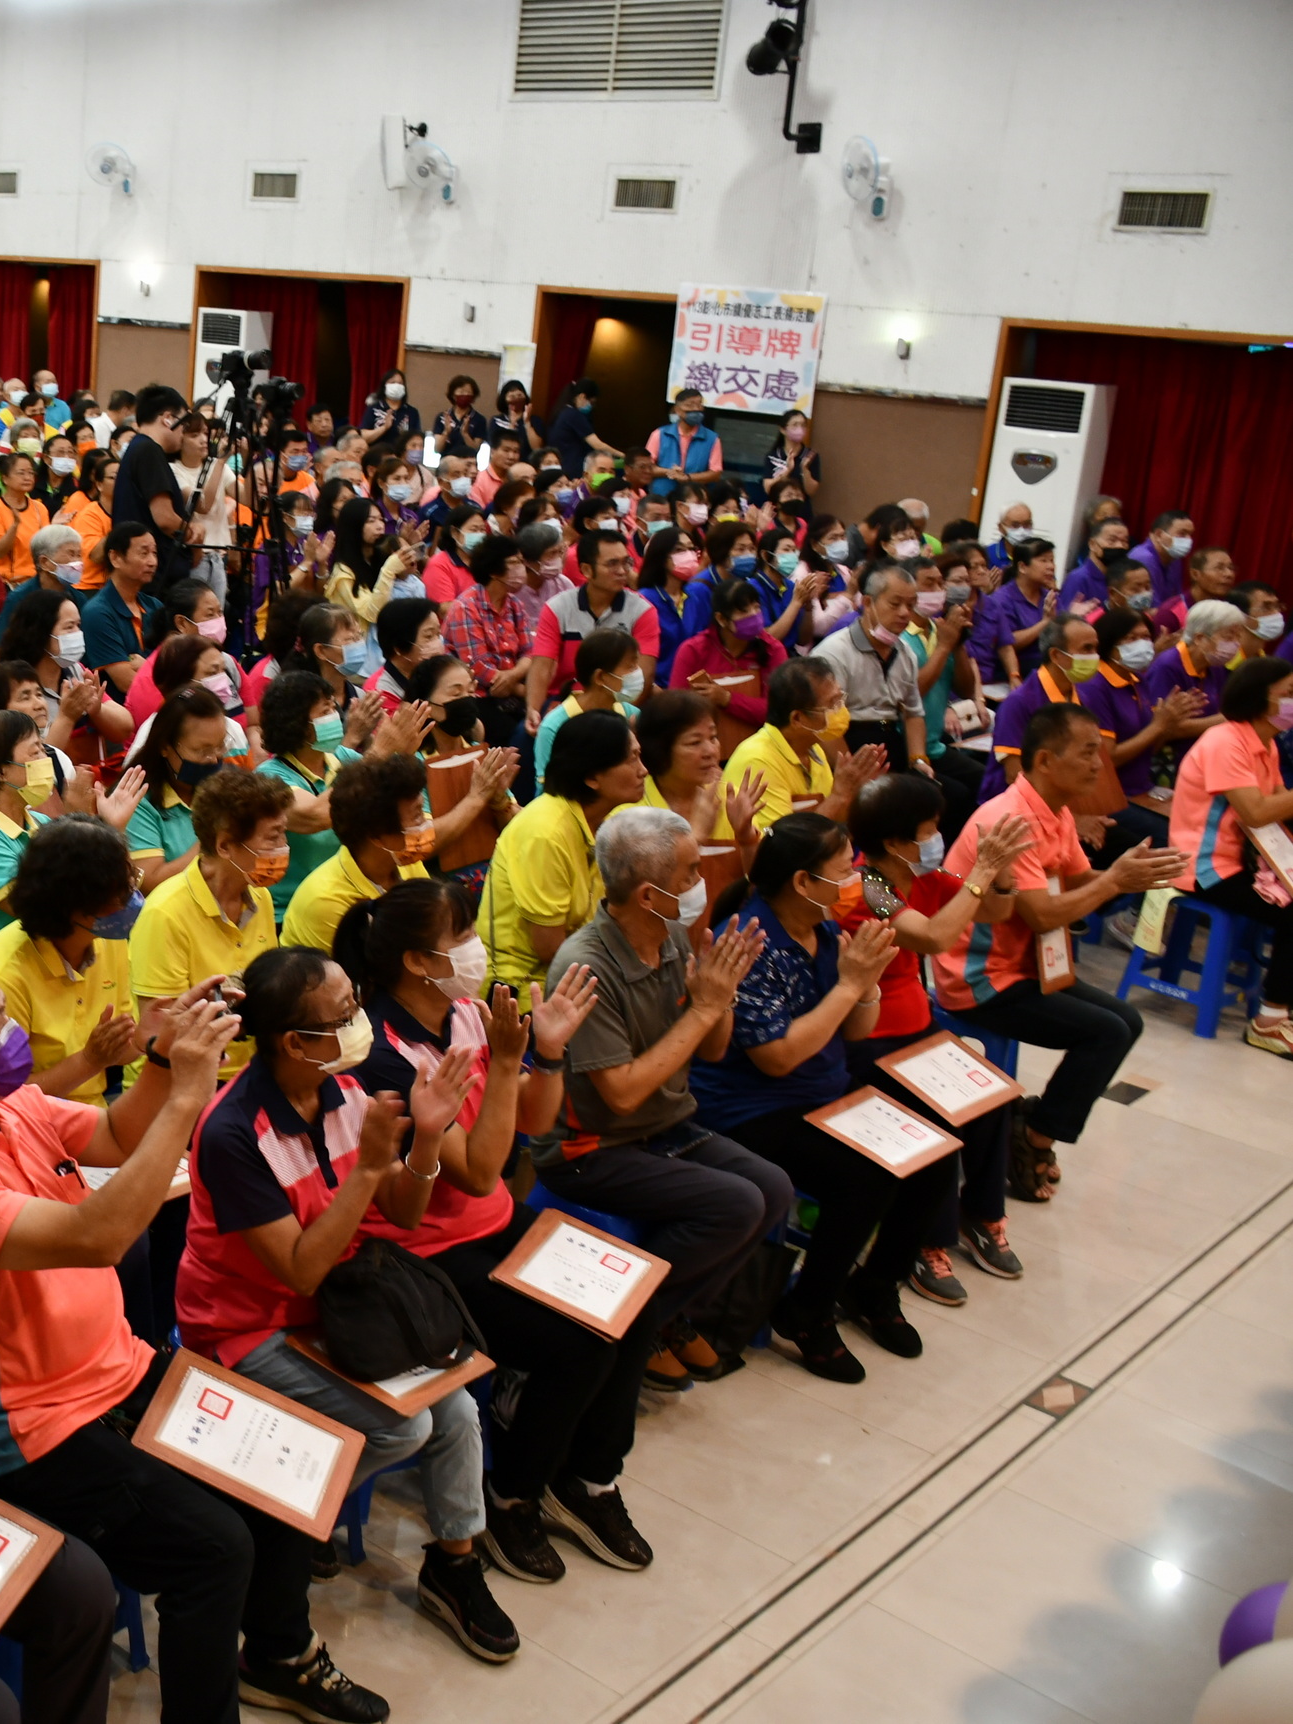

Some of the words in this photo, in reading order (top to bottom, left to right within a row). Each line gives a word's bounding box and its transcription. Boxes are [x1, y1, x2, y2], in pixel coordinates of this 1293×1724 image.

[689, 322, 802, 360] 引導牌
[684, 361, 800, 402] 繳交處
